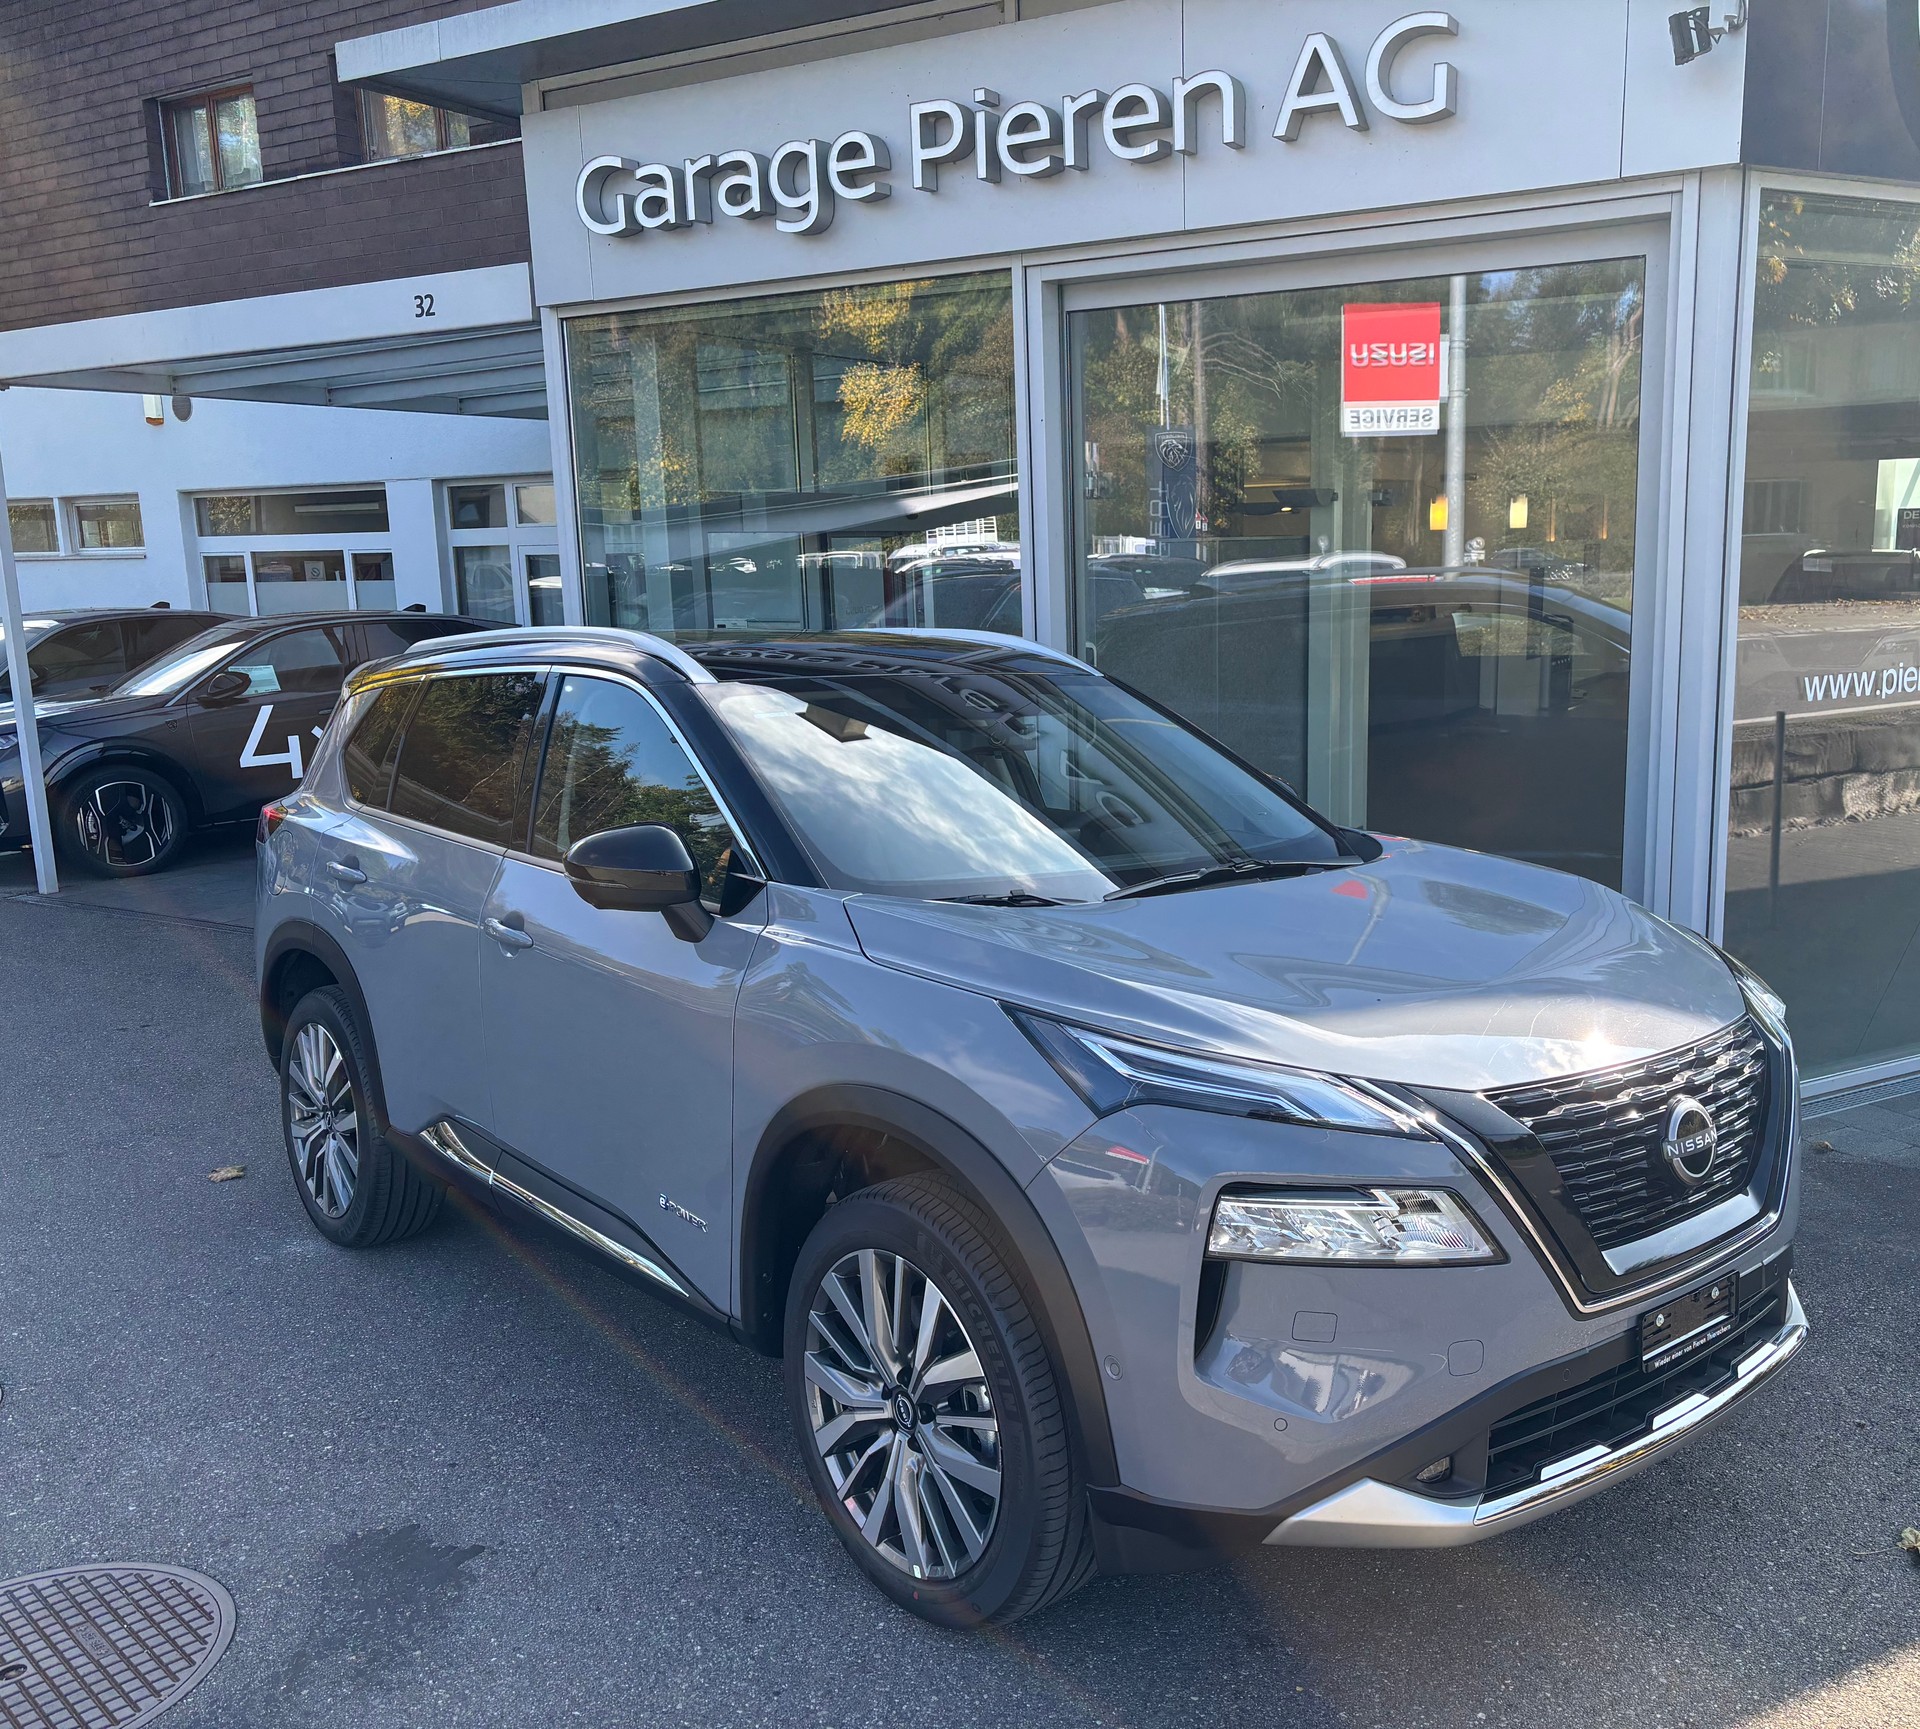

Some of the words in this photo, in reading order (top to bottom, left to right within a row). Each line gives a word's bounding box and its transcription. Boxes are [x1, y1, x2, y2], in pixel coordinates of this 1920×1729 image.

[575, 130, 891, 236] Garage
[910, 70, 1246, 191] Pieren
[1273, 11, 1459, 142] AG
[414, 294, 436, 318] 32
[1804, 662, 1920, 702] www.pie
[240, 704, 324, 779] 4
[1667, 1124, 1717, 1157] NISSAN
